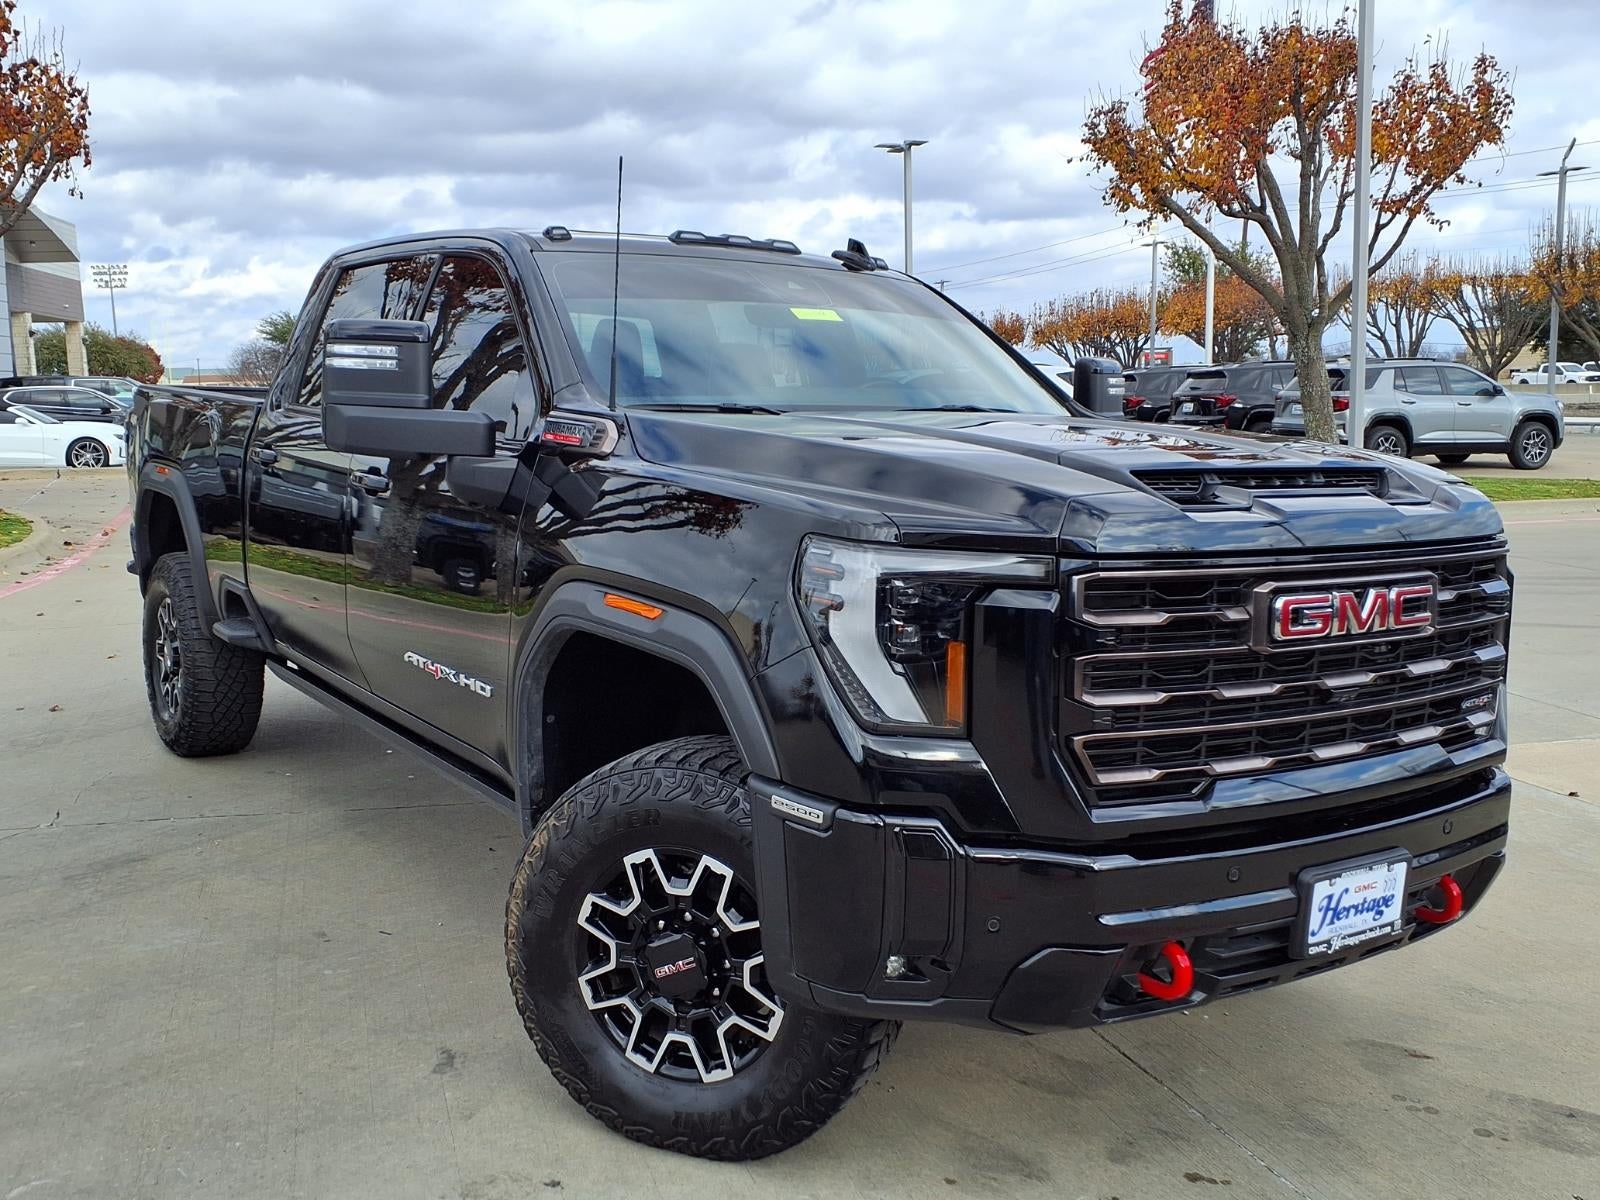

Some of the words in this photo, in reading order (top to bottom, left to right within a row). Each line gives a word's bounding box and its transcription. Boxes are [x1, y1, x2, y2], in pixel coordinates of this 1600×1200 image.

[1272, 584, 1433, 640] GMC
[773, 799, 821, 819] 2500
[1354, 881, 1378, 893] GMC
[1310, 887, 1395, 937] Heritage
[654, 956, 696, 979] GMC
